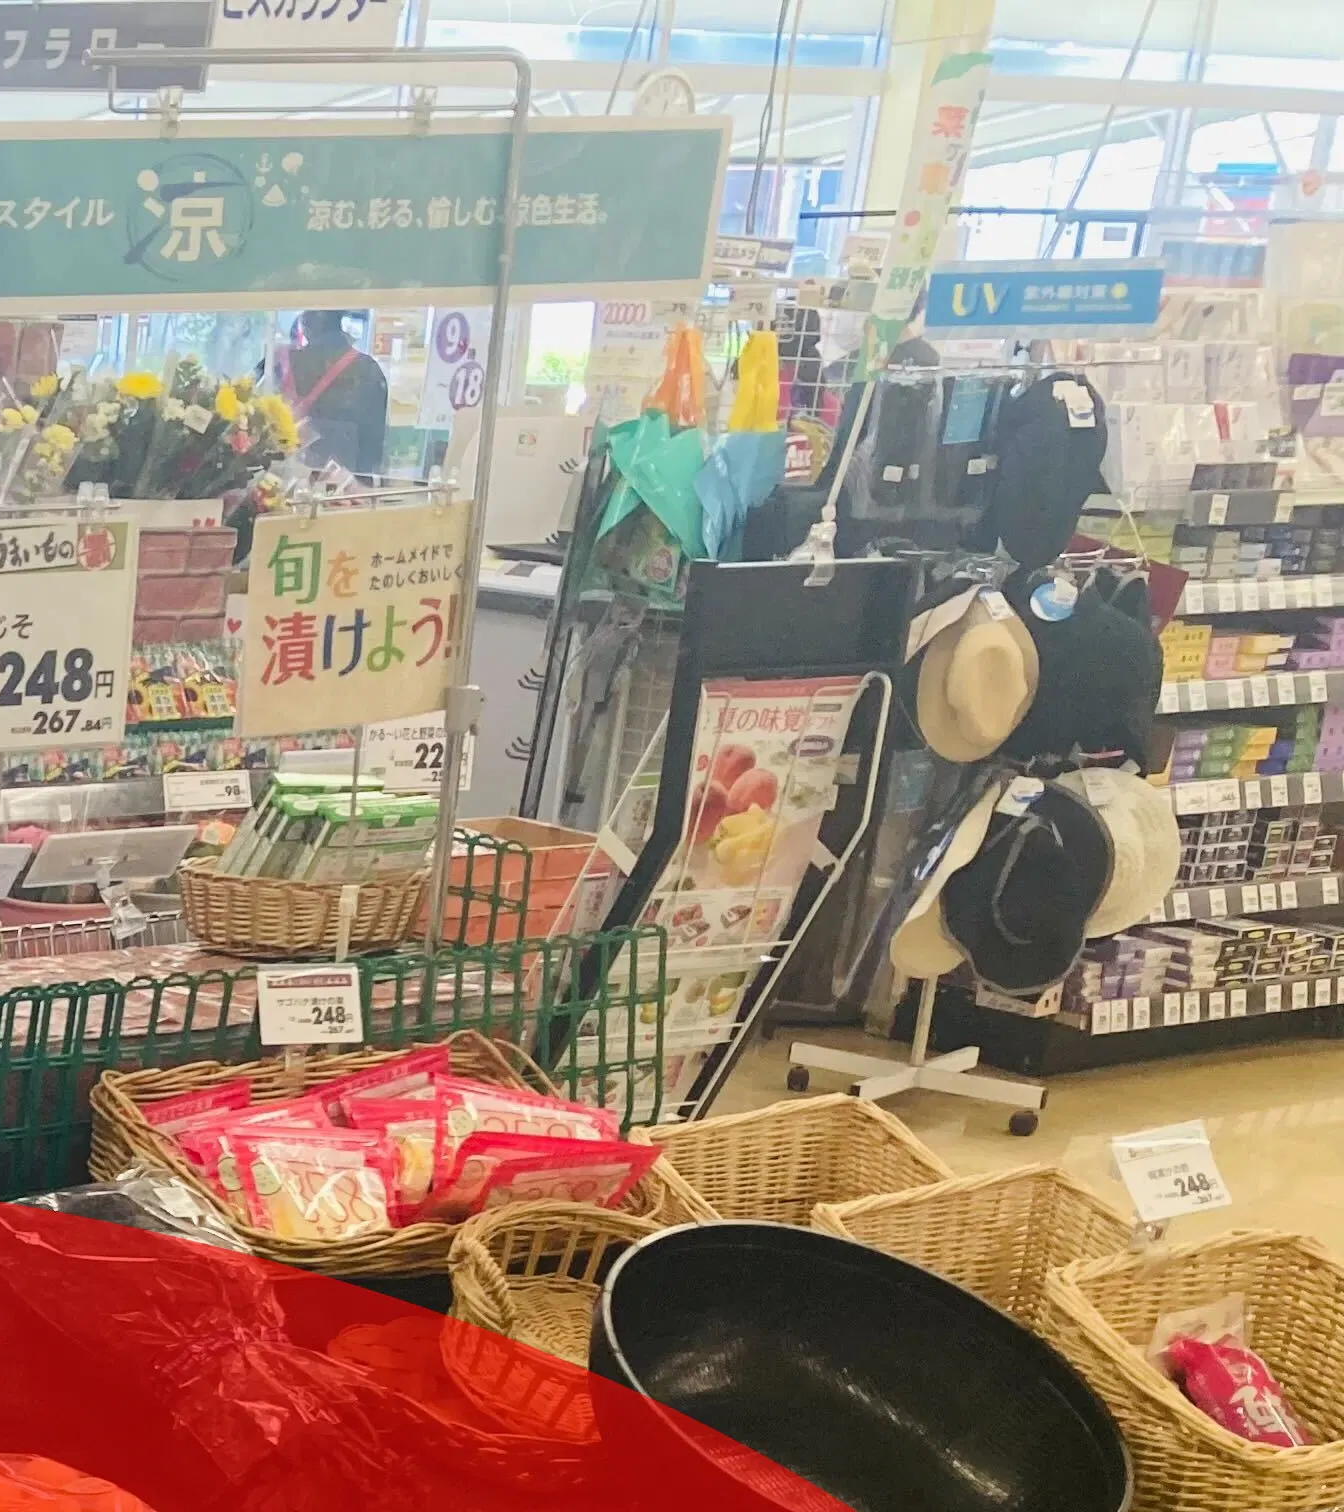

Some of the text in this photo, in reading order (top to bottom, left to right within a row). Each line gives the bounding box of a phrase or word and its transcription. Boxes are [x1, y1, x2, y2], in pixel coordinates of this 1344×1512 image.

[952, 283, 1010, 317] UV
[267, 534, 360, 605] 旬を
[370, 543, 454, 569] ホームメイドで
